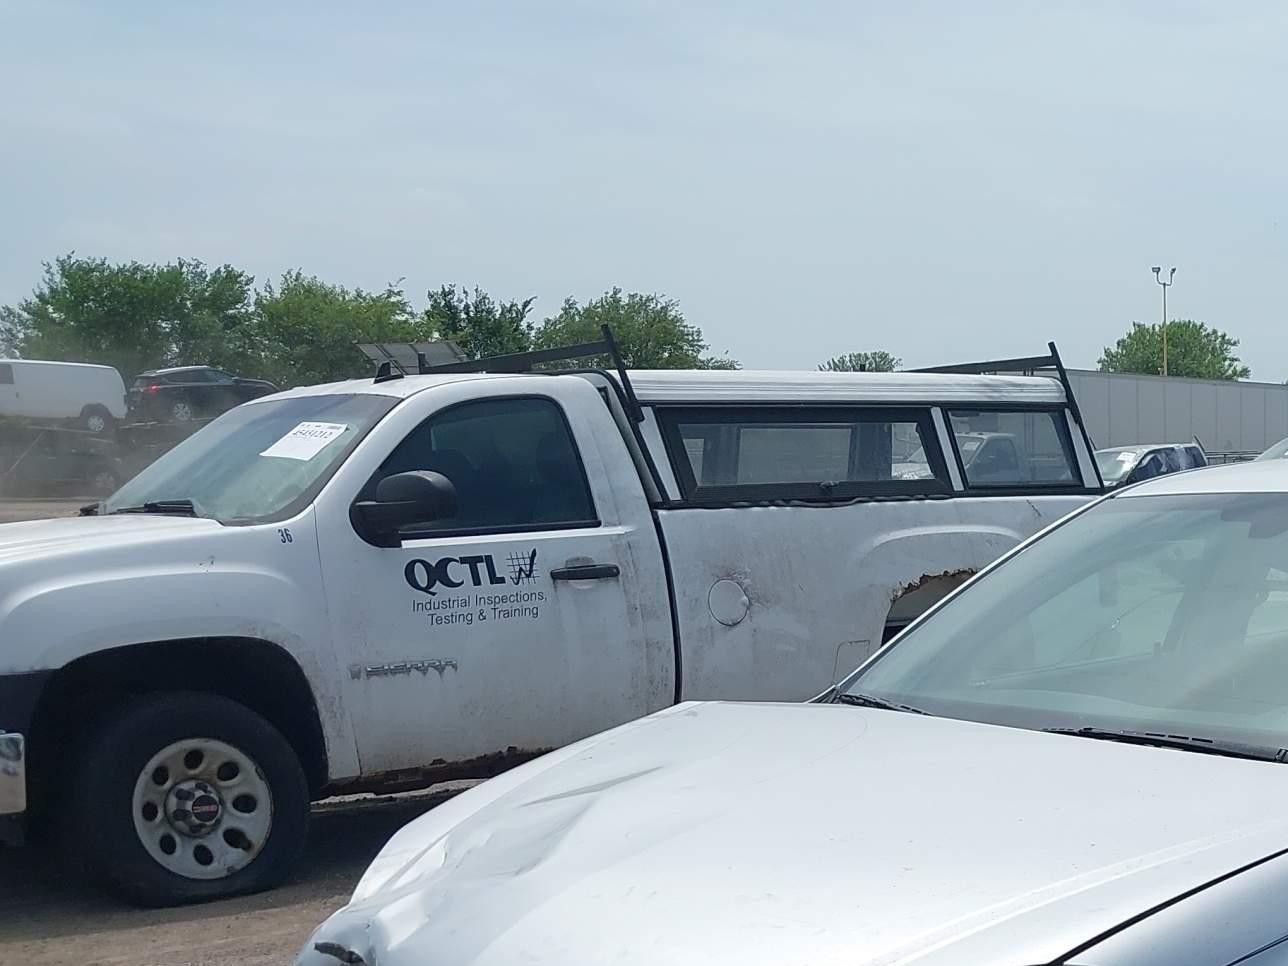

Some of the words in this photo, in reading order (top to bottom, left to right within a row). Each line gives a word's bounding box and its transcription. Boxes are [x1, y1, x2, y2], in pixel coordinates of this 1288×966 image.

[277, 528, 293, 544] 36
[404, 554, 506, 596] QCTL
[412, 595, 471, 612] Industrial
[475, 590, 548, 607] Inspections,
[427, 611, 473, 626] Testing
[478, 608, 487, 621] &
[491, 605, 539, 619] Training
